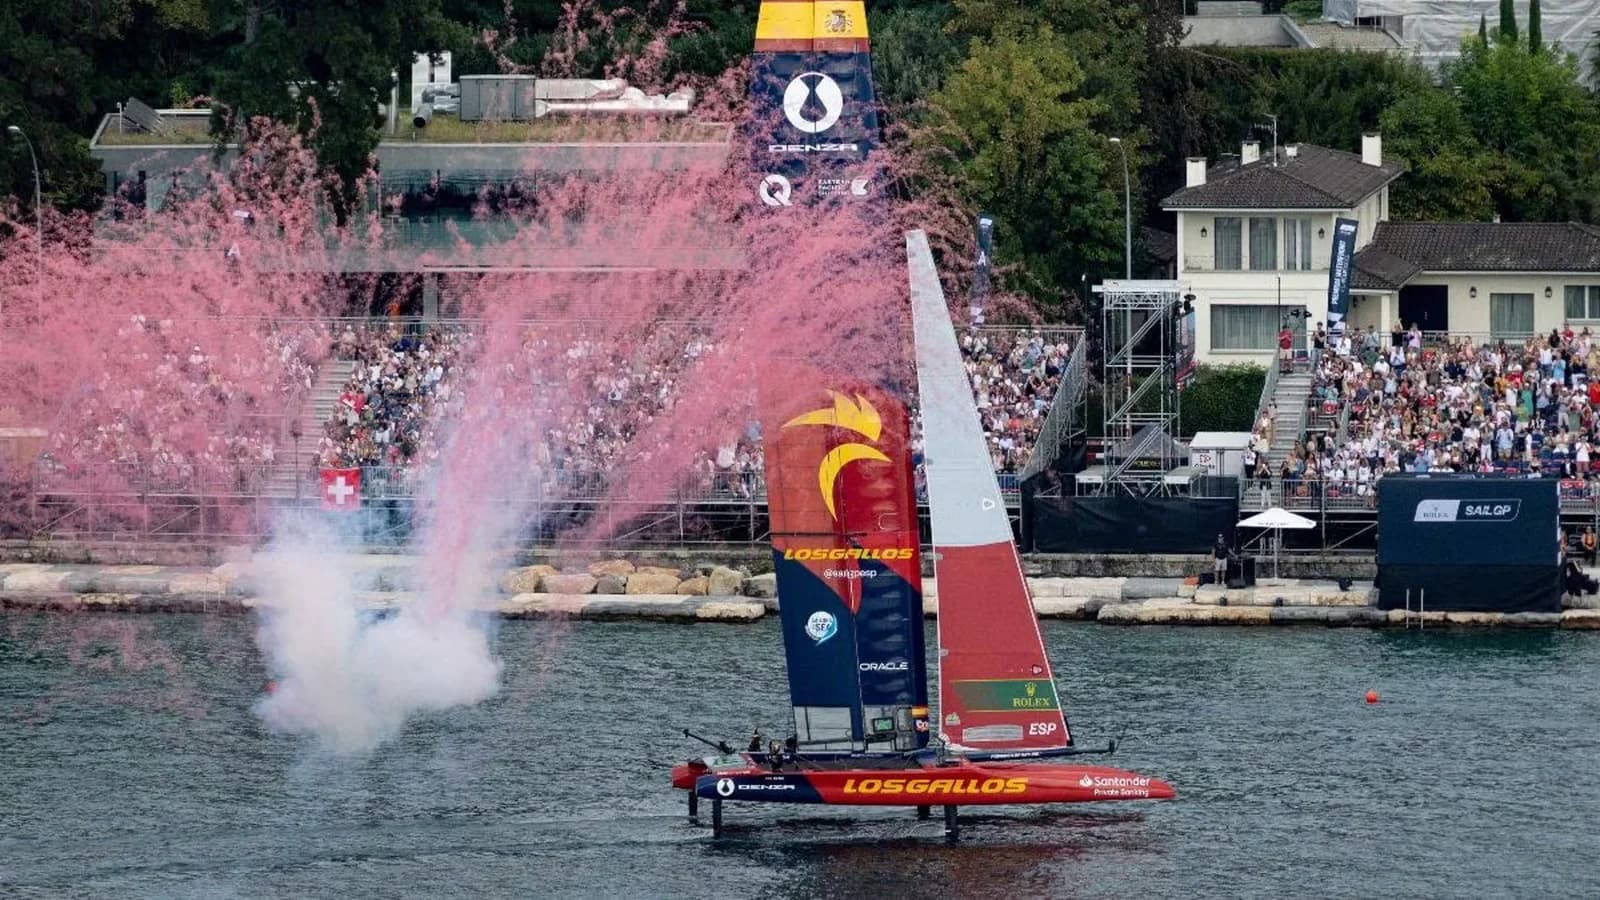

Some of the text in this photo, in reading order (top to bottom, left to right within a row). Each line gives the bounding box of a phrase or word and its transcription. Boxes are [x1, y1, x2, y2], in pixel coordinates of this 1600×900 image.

[769, 144, 858, 152] DENZA
[859, 661, 909, 671] ORACLE
[1012, 698, 1051, 708] ROLEX
[1028, 723, 1057, 735] ESP
[1093, 776, 1151, 787] Santander
[1094, 788, 1149, 797] Private Banking
